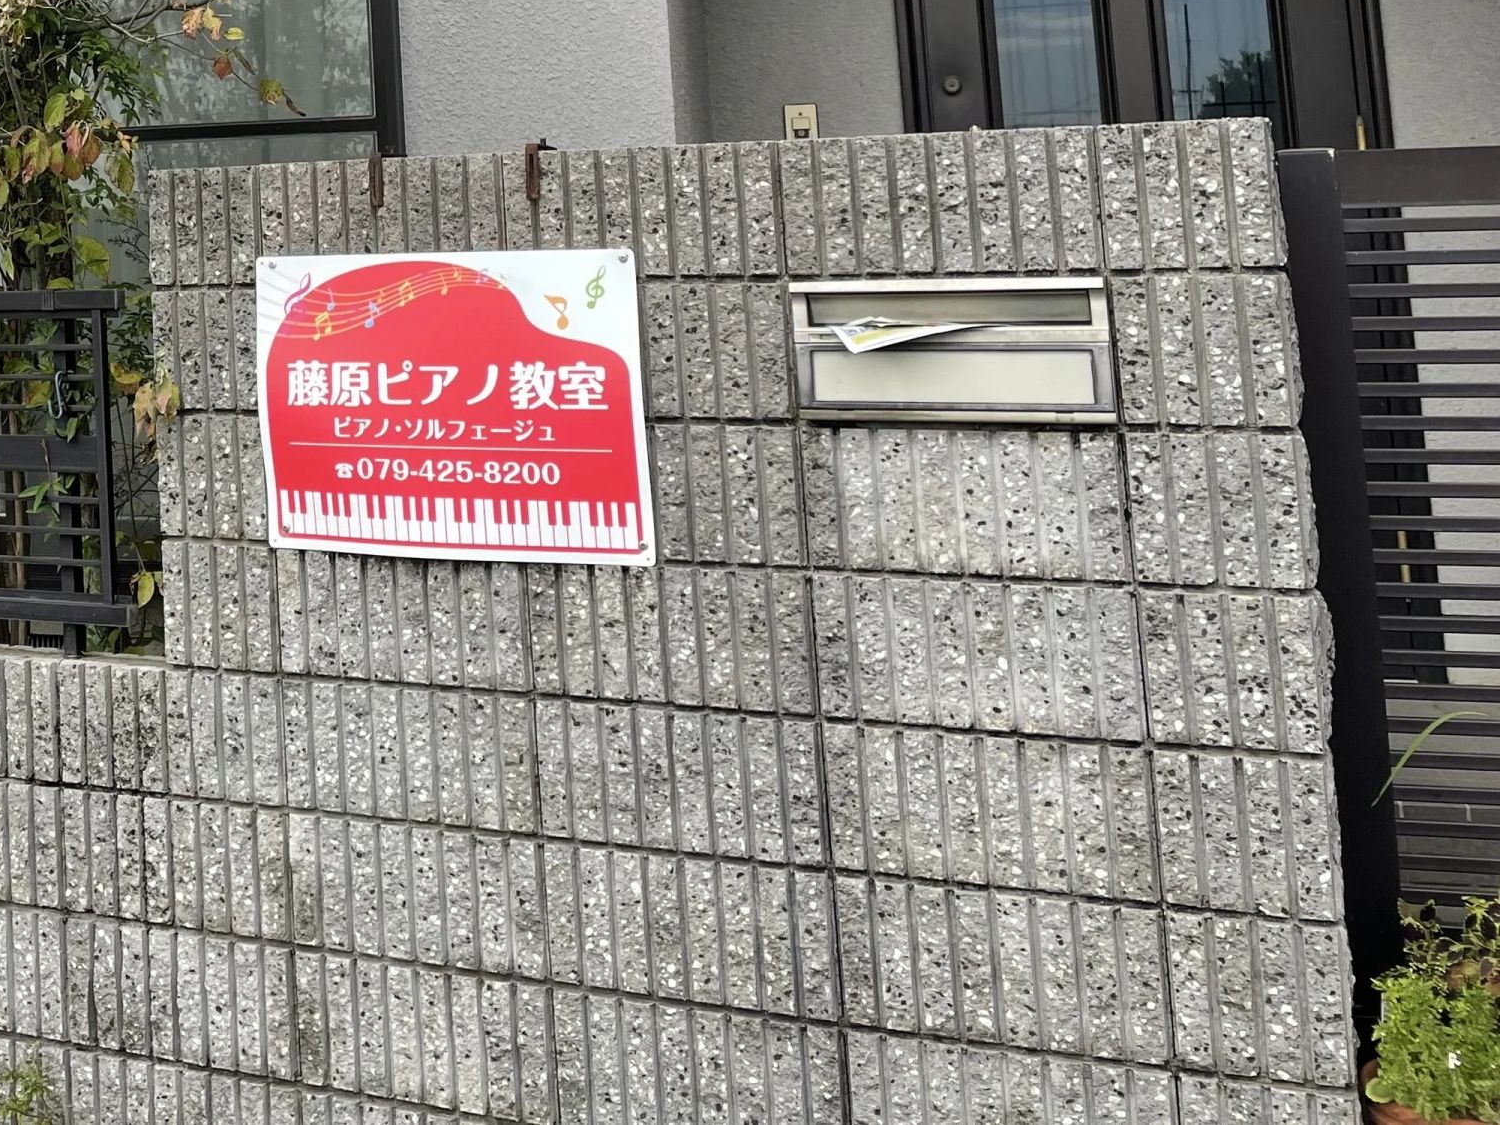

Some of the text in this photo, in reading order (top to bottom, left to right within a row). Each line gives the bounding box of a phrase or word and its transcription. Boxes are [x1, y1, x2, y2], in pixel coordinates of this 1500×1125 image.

[286, 359, 609, 411] 藤原ピアノ教室
[333, 415, 556, 442] ピアノ・ソルフェージュ
[356, 457, 561, 486] 079-425-8200
